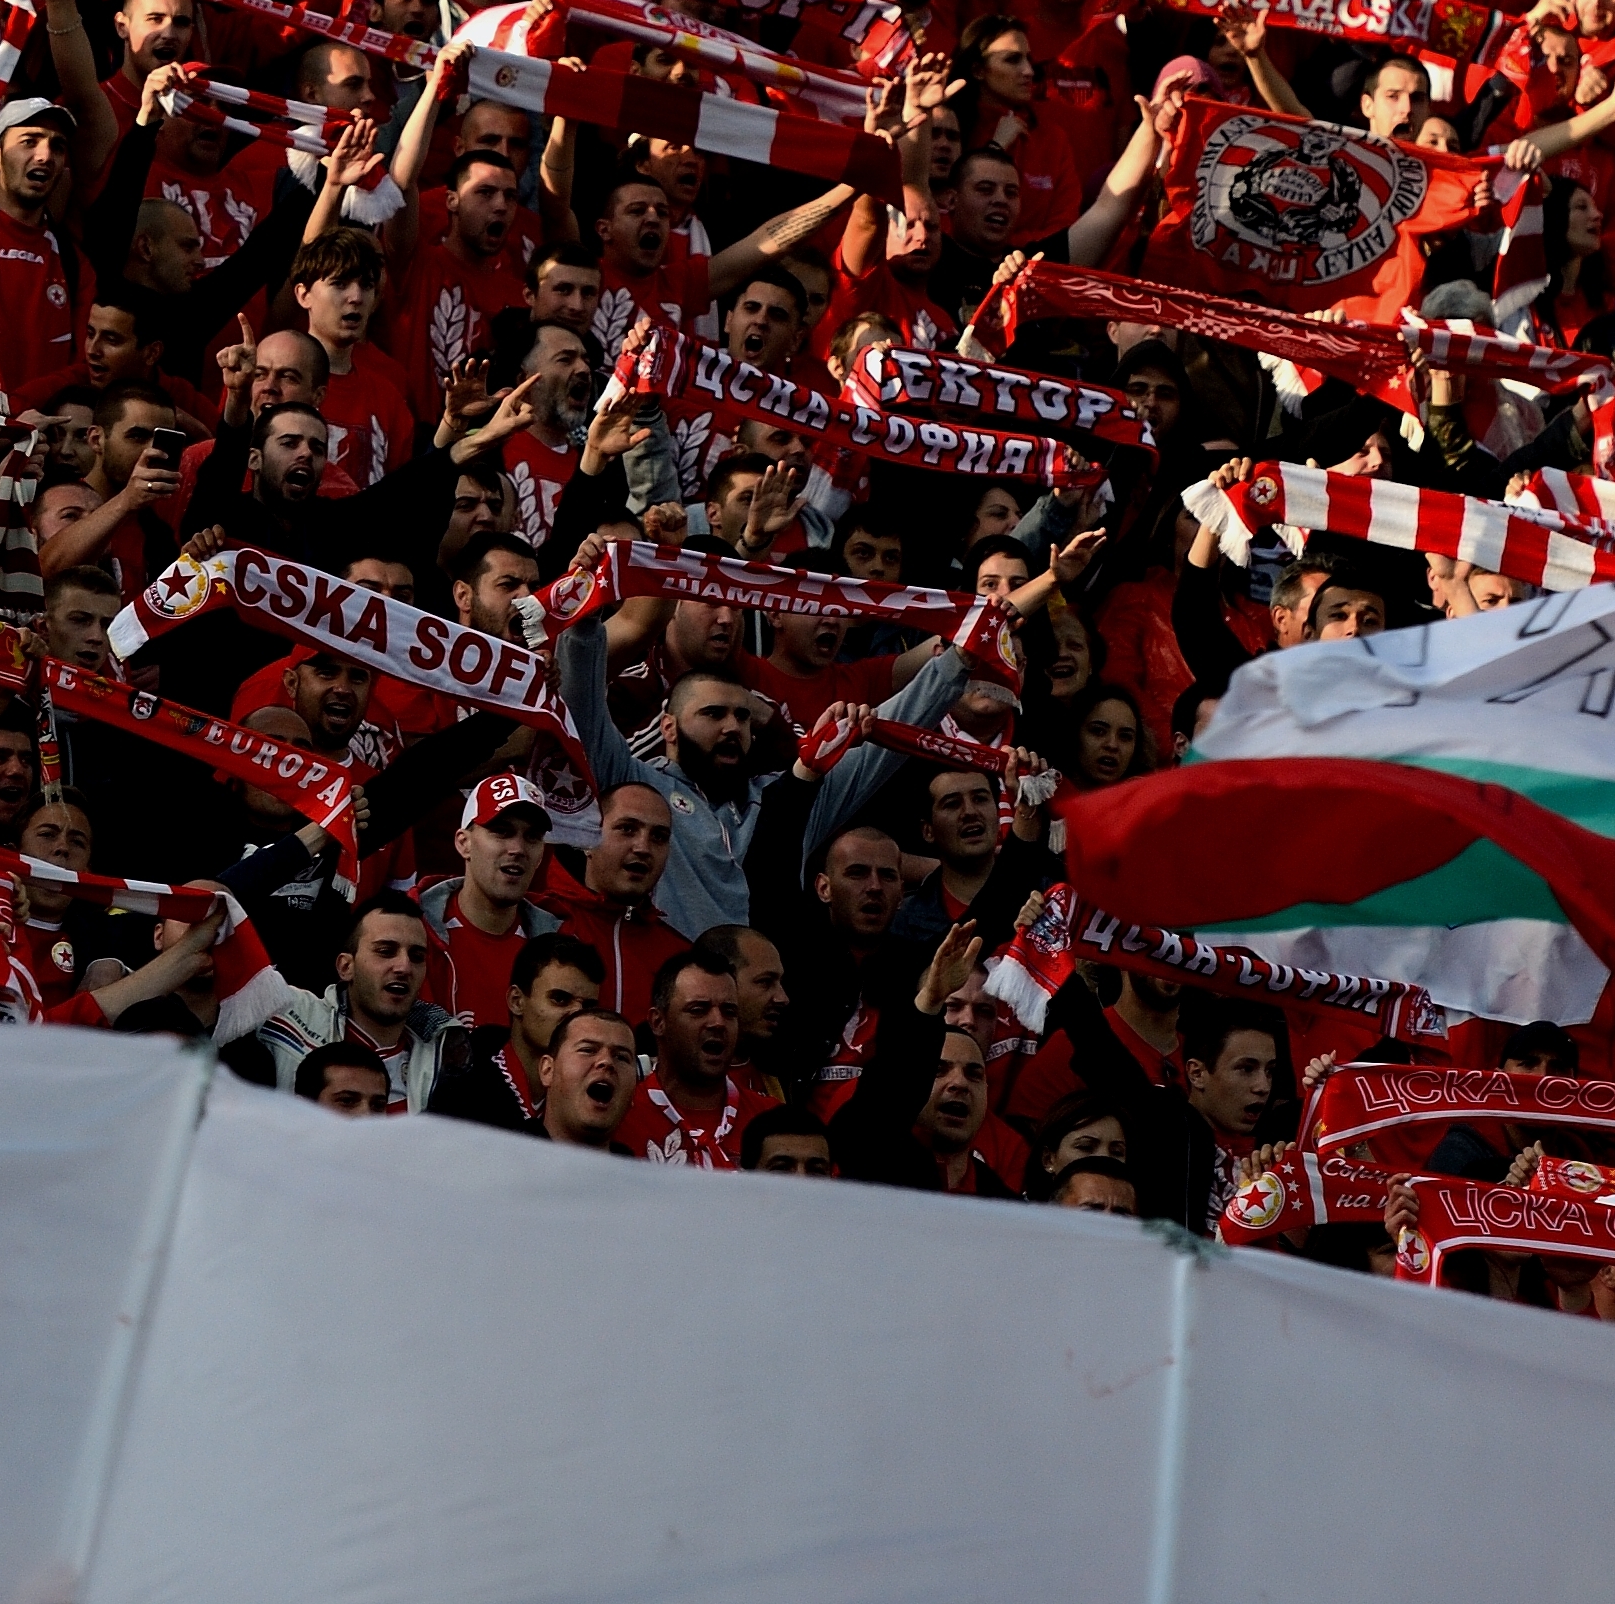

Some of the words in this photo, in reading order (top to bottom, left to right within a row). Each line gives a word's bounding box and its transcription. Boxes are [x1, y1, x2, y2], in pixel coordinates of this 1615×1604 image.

[232, 544, 389, 659] CSKA
[203, 719, 342, 793] EUROPA
[1353, 1068, 1521, 1114] ЦСКА
[1438, 1186, 1589, 1234] ЦСКА
